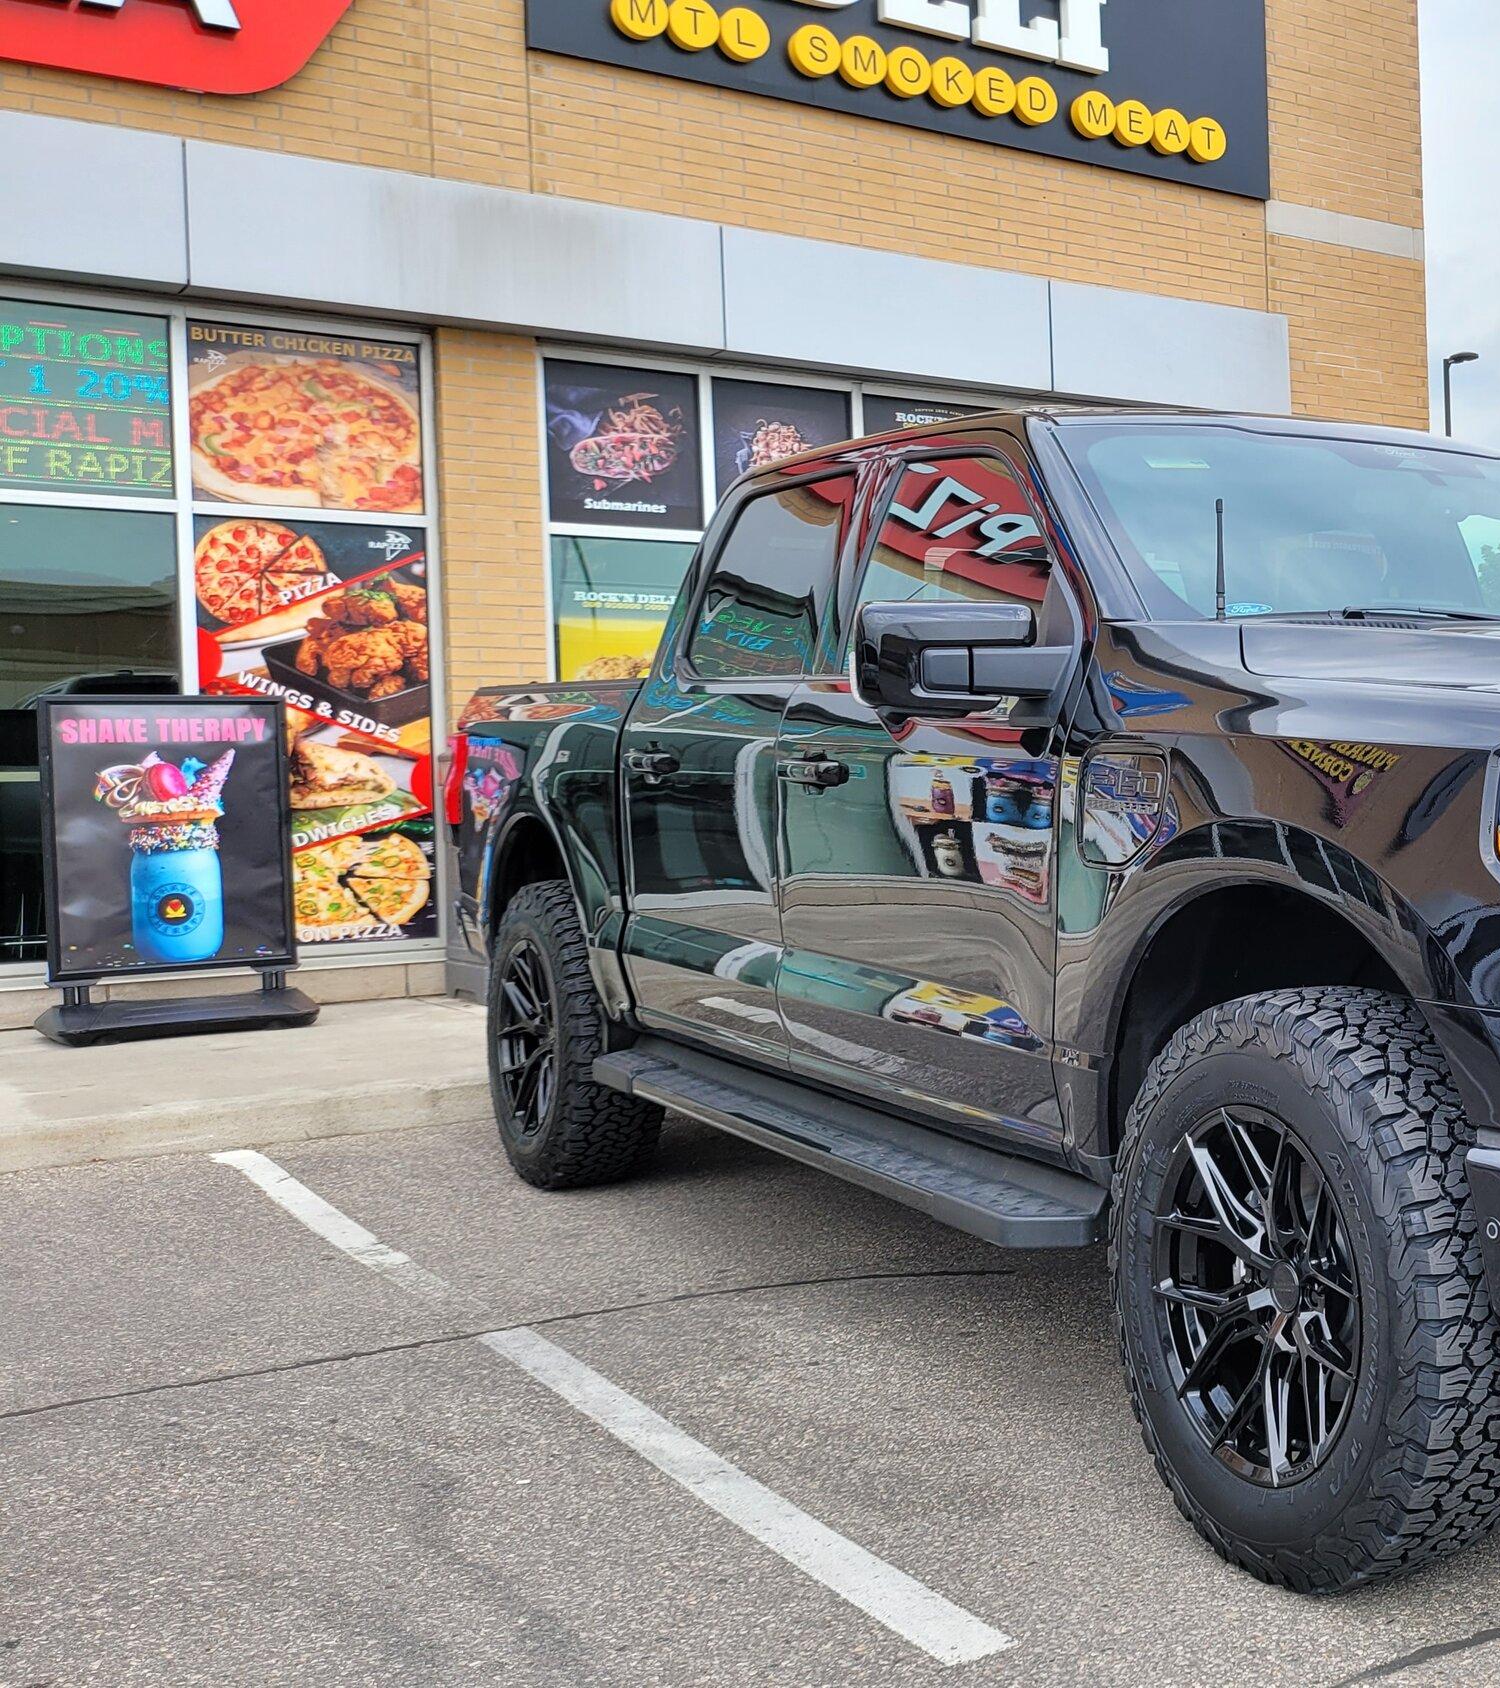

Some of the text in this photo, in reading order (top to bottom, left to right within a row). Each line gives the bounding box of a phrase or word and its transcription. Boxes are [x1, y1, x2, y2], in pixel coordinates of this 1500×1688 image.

[627, 0, 1219, 152] MTL SMOKED MEAT
[190, 326, 416, 363] BUTTER CHICKEN PIZZA
[584, 498, 667, 514] Submarines
[278, 571, 344, 605] PIZZA
[238, 671, 402, 743] WINGS & SIDES
[61, 718, 267, 745] SHAKE THERAPY
[336, 923, 405, 941] PIZZA
